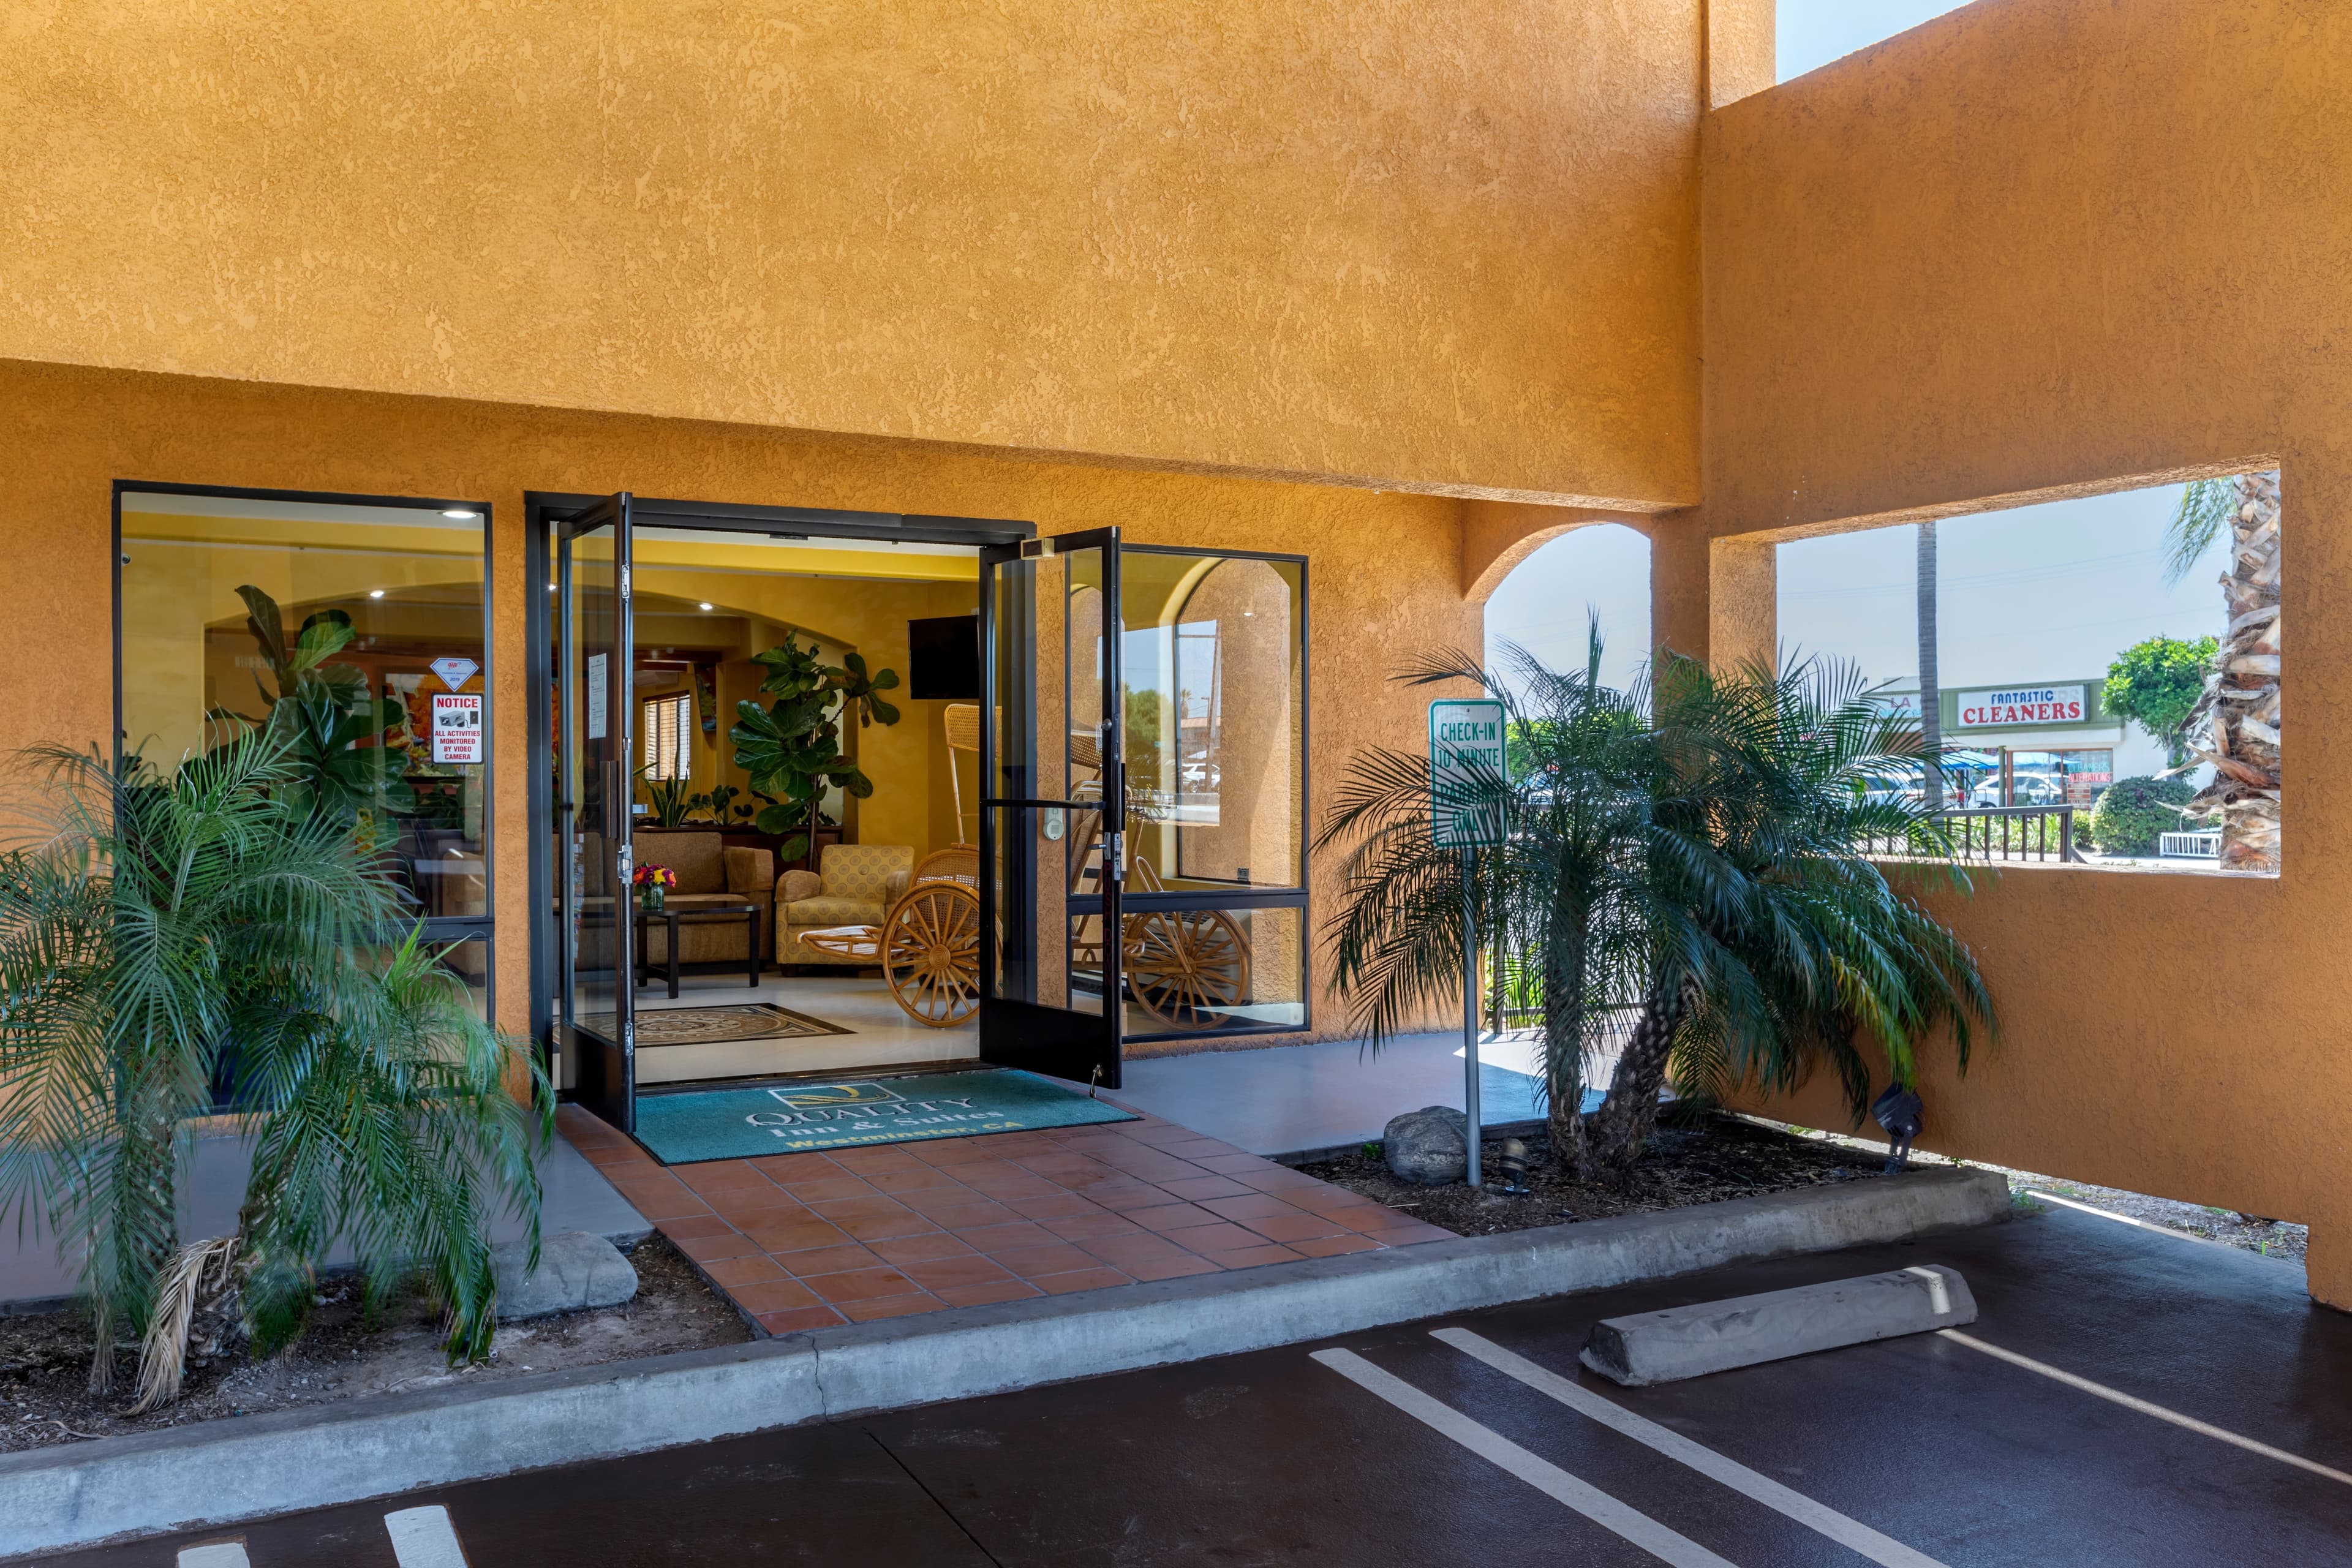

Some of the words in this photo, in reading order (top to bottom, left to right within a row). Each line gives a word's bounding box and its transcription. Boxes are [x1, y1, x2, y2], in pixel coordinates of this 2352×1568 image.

[437, 698, 478, 708] NOTICE
[1891, 697, 1911, 708] LA
[1991, 690, 2054, 704] FANTASTIC
[1963, 702, 2080, 724] CLEANERS
[1441, 722, 1496, 741] CHECK-IN
[1438, 749, 1450, 767] 10
[1457, 748, 1499, 767] MINUTE
[2068, 763, 2110, 772] CLEANERS
[2068, 773, 2111, 782] ALTERATIONS
[745, 1098, 979, 1126] QUALITY
[769, 1126, 840, 1137] Inn
[852, 1121, 885, 1130] &
[893, 1111, 1005, 1126] Suites
[785, 1128, 978, 1148] Westminster,
